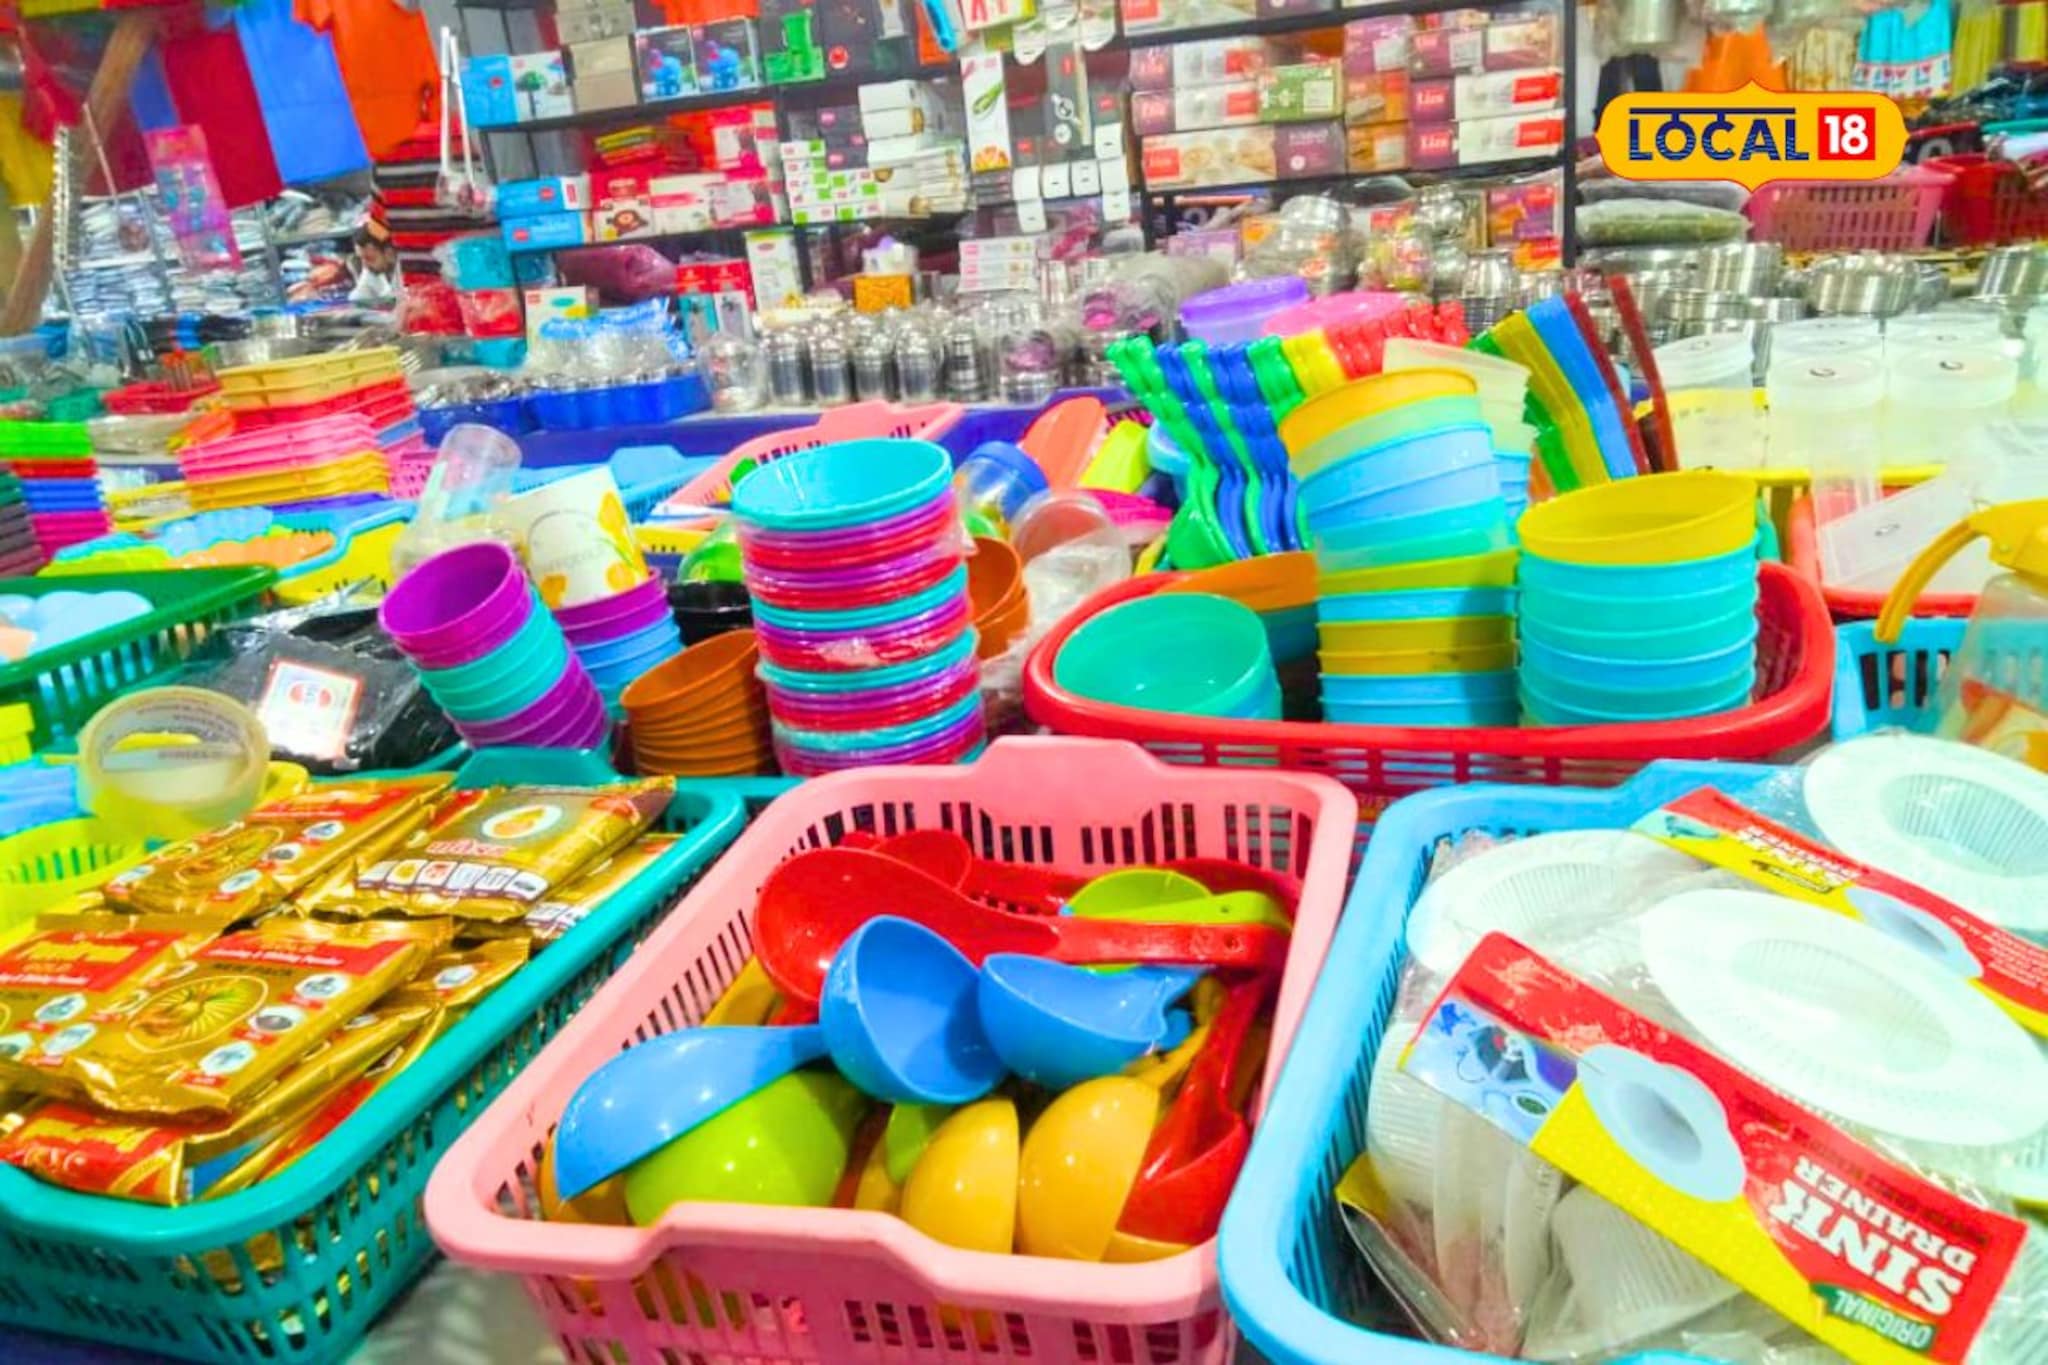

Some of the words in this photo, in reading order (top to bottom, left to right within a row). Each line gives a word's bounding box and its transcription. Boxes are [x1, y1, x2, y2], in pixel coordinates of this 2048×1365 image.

[1768, 1178, 1964, 1317] SINK
[1794, 1156, 1978, 1276] DRAINER
[1833, 1288, 1934, 1349] ORIGINAL
